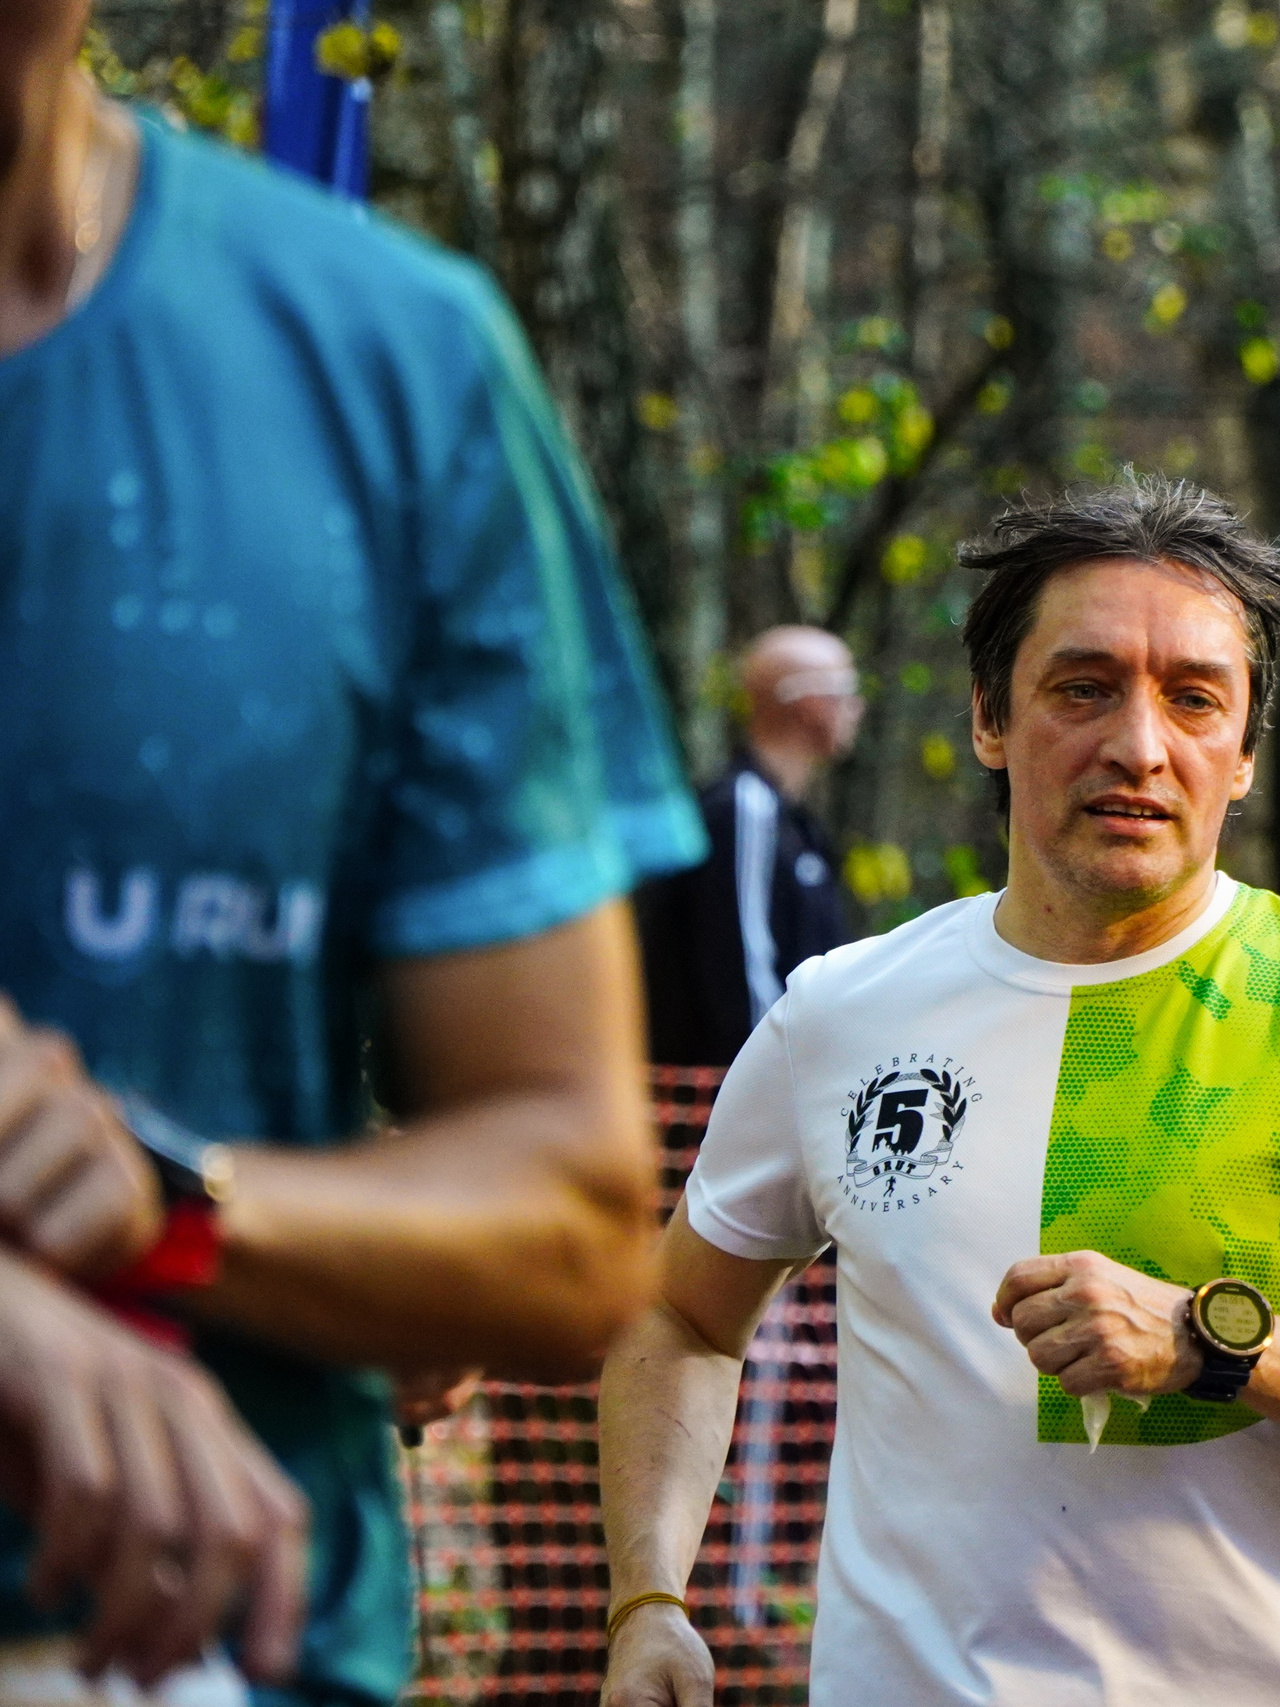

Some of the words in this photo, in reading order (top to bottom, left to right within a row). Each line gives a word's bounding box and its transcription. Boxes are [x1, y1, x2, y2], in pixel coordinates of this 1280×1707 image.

[840, 1053, 983, 1117] CELEBRATING
[871, 1089, 929, 1156] 5
[837, 1160, 965, 1213] ANNIVERSARY
